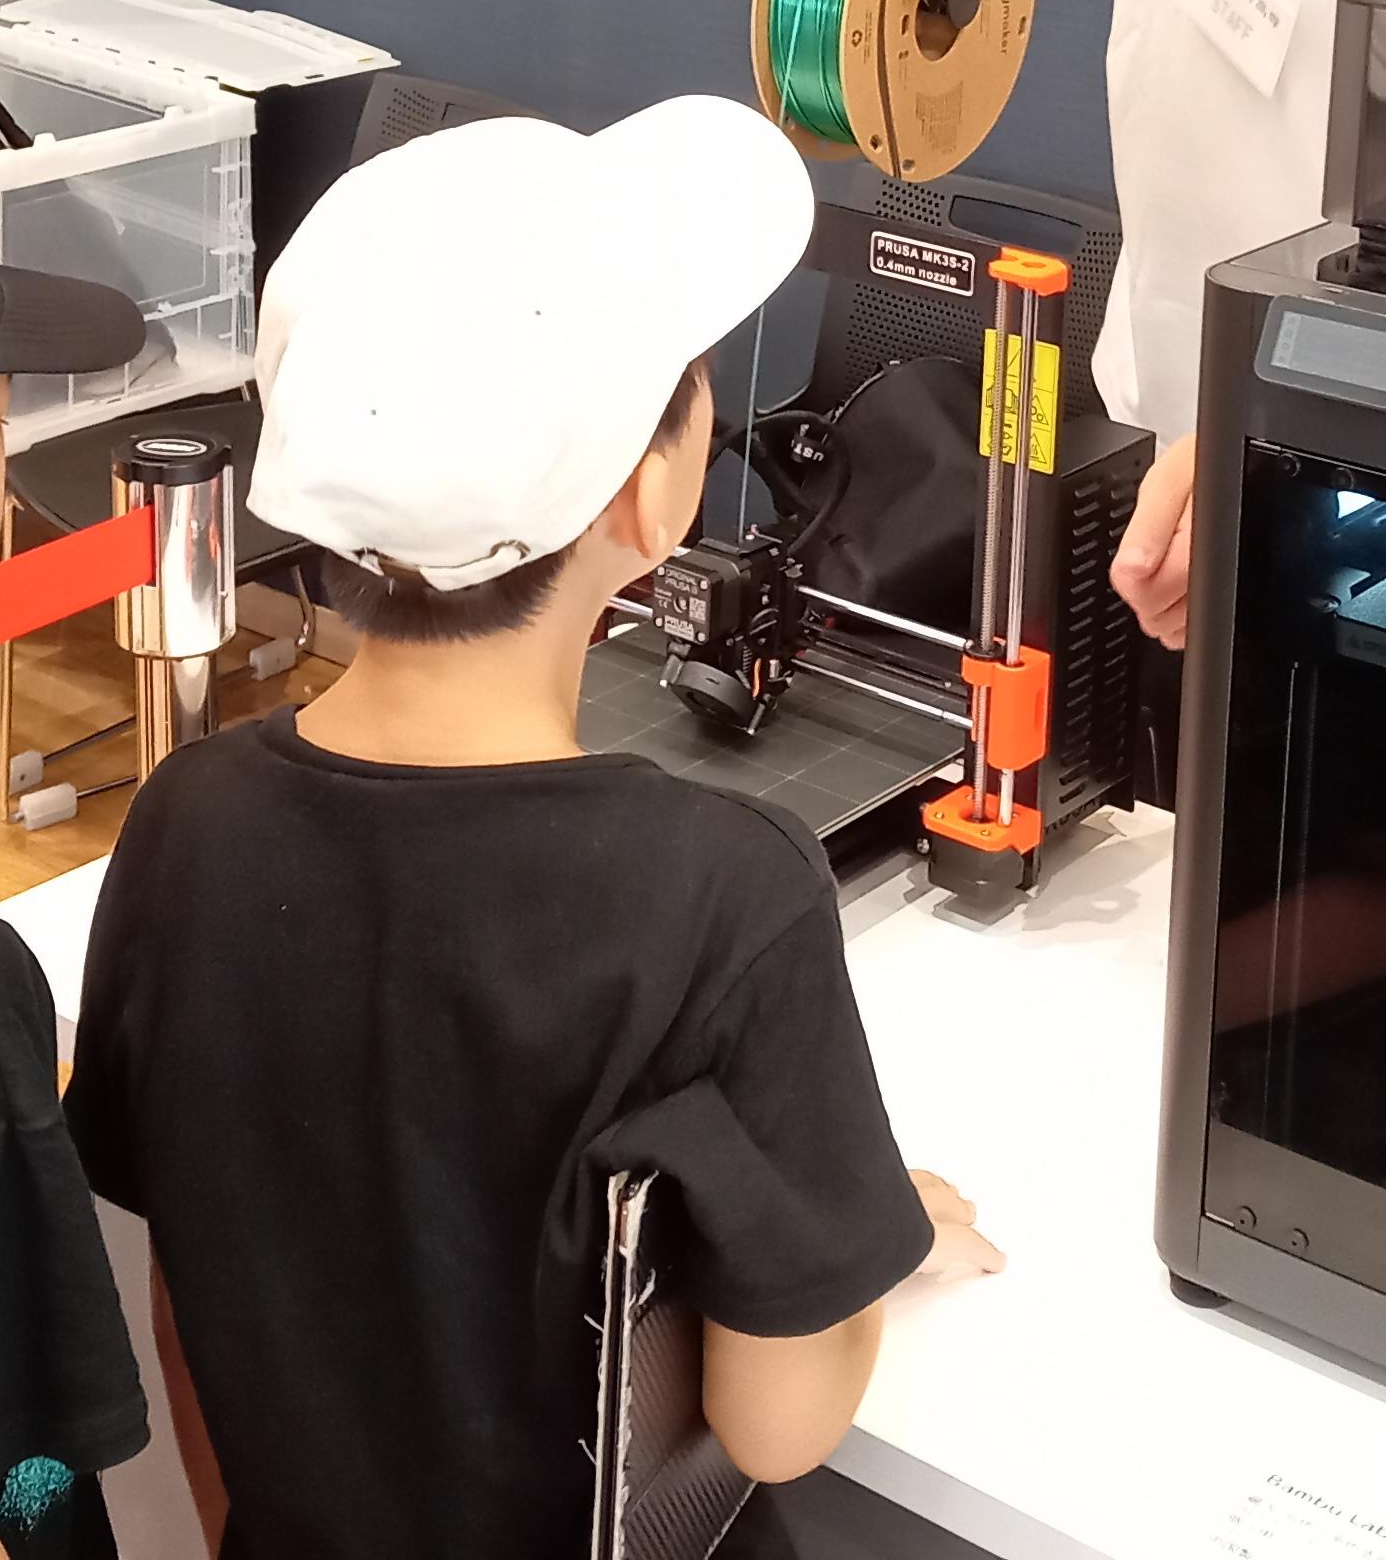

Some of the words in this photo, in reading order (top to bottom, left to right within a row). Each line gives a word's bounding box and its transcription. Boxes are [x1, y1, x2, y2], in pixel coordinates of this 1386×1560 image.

[876, 256, 916, 276] 0.4mm
[918, 268, 958, 286] nozzle
[877, 239, 920, 260] PRUSA
[921, 250, 970, 272] MK3S-2
[1267, 1474, 1342, 1517] Bambu
